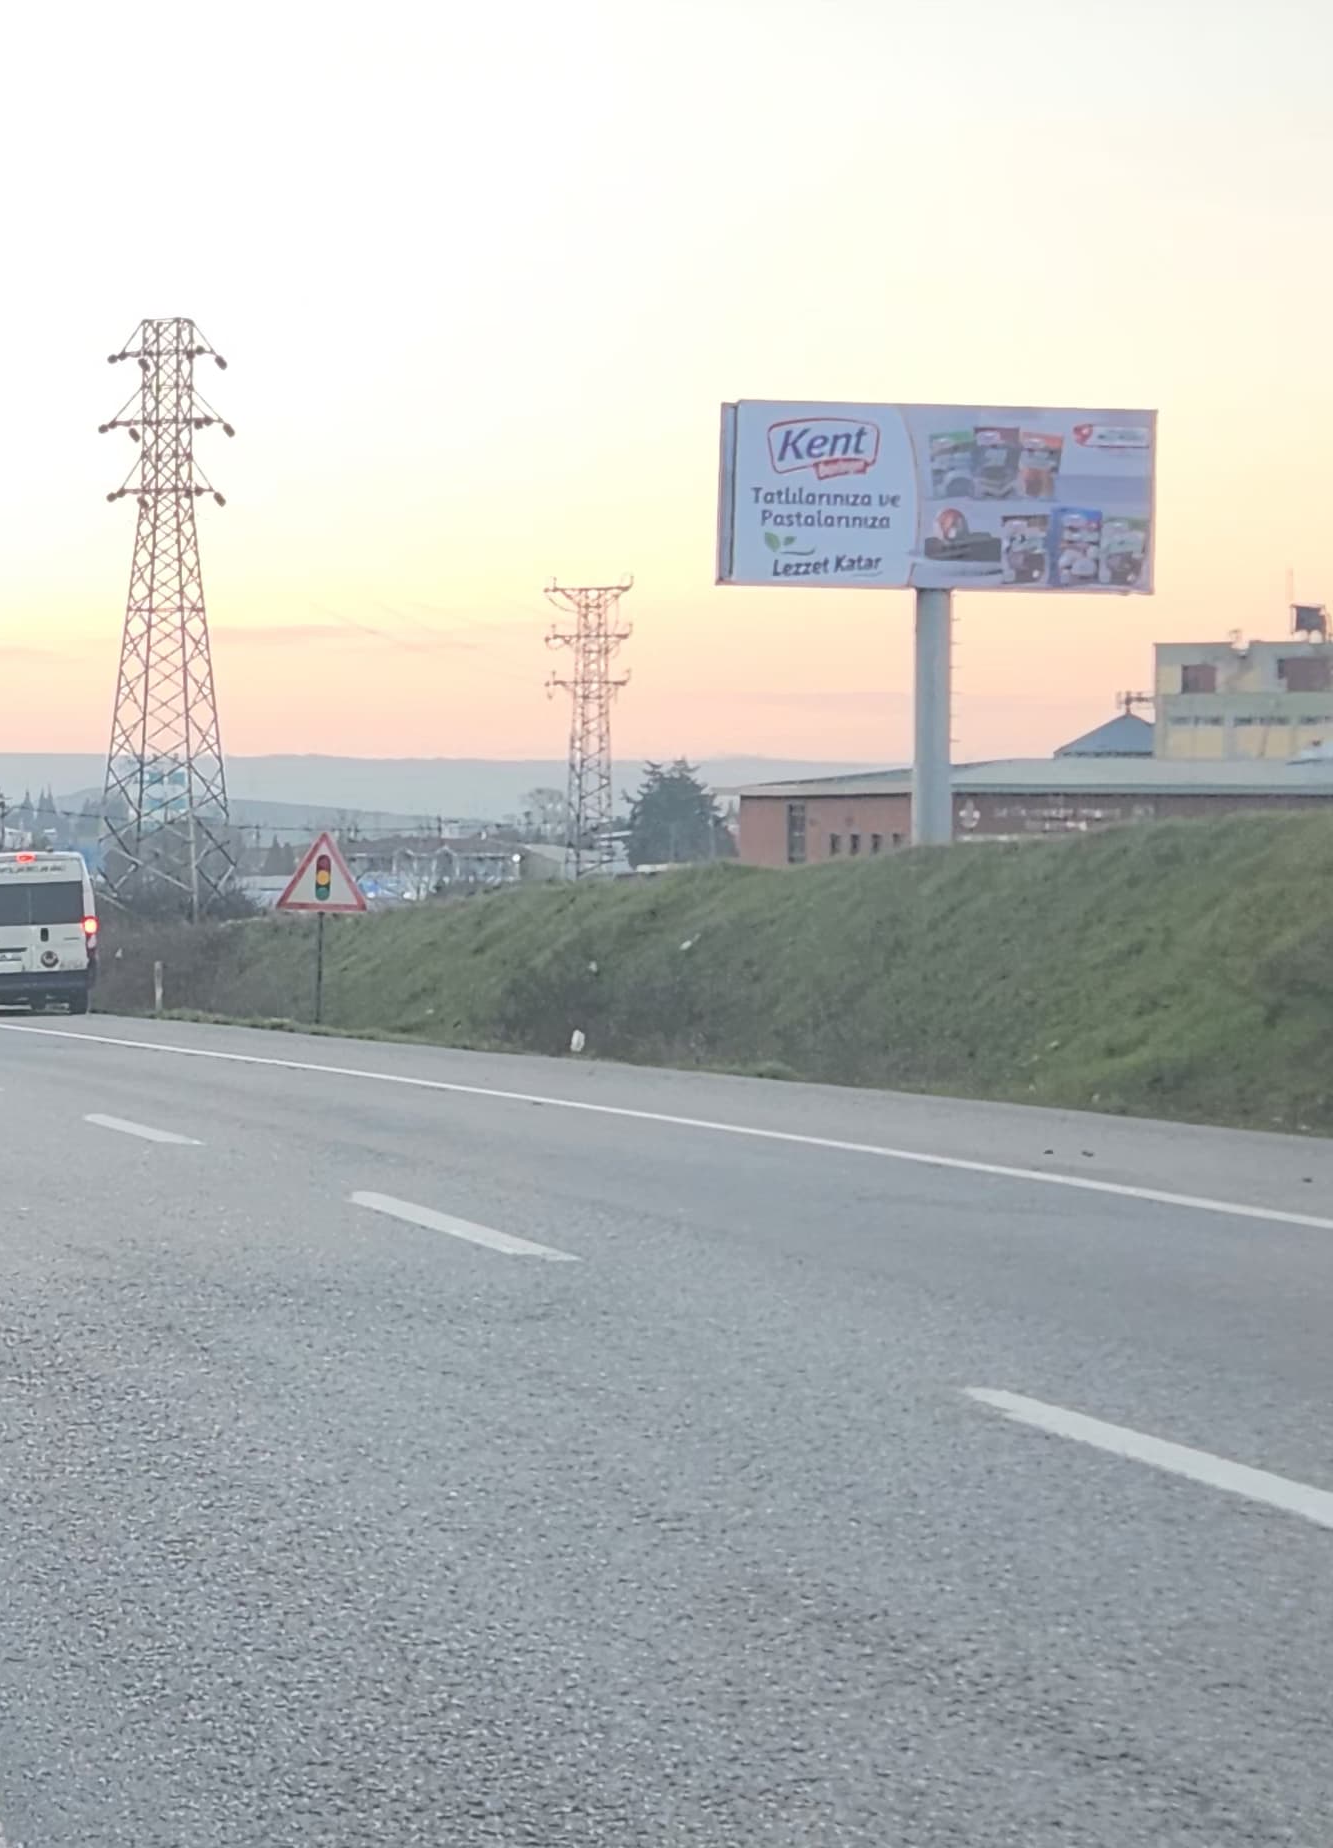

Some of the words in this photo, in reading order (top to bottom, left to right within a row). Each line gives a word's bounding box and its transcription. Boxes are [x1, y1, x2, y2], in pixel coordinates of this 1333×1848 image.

[777, 426, 868, 462] Kent
[751, 487, 872, 507] Tatlılarınıza
[878, 494, 901, 507] ve
[760, 509, 891, 529] Pastalarınıza
[773, 557, 829, 576] Lezzet
[835, 555, 882, 572] Katar
